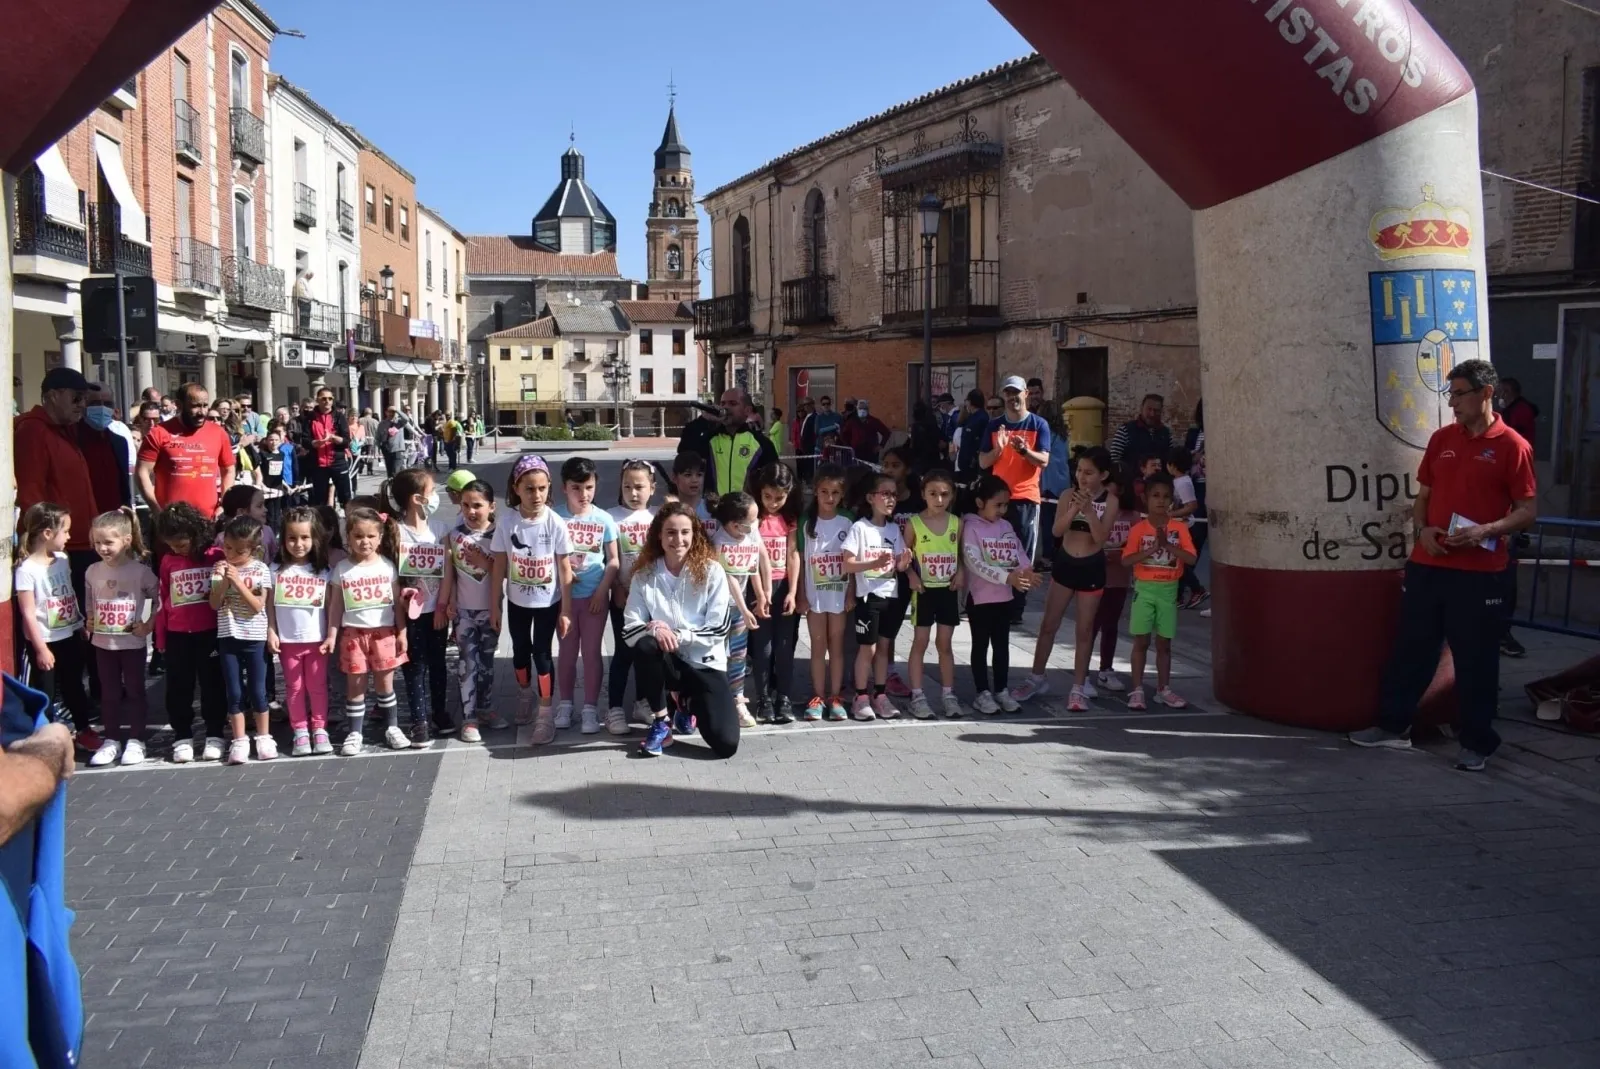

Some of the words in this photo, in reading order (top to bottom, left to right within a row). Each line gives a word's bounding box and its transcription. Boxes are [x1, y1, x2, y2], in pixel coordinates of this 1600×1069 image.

[1336, 0, 1427, 88] ROS
[1250, 0, 1378, 115] ISTAS
[1326, 463, 1419, 511] Dipu
[567, 521, 604, 533] edunia
[629, 532, 647, 546] 31
[1302, 531, 1341, 561] de
[1361, 521, 1408, 561] Sa
[400, 545, 444, 556] bedunia
[721, 544, 758, 554] bedunia
[990, 549, 1013, 562] 342
[408, 555, 436, 569] 339
[512, 553, 553, 567] bedunia
[728, 554, 752, 567] 327
[811, 553, 844, 565] beduni
[518, 566, 546, 579] 300
[819, 563, 842, 577] 311
[929, 564, 952, 577] 314
[277, 574, 325, 587] bedunia
[342, 575, 390, 590] bedunia
[176, 580, 205, 597] 332
[284, 585, 315, 599] 289
[353, 585, 383, 602] 336
[99, 612, 128, 626] 288
